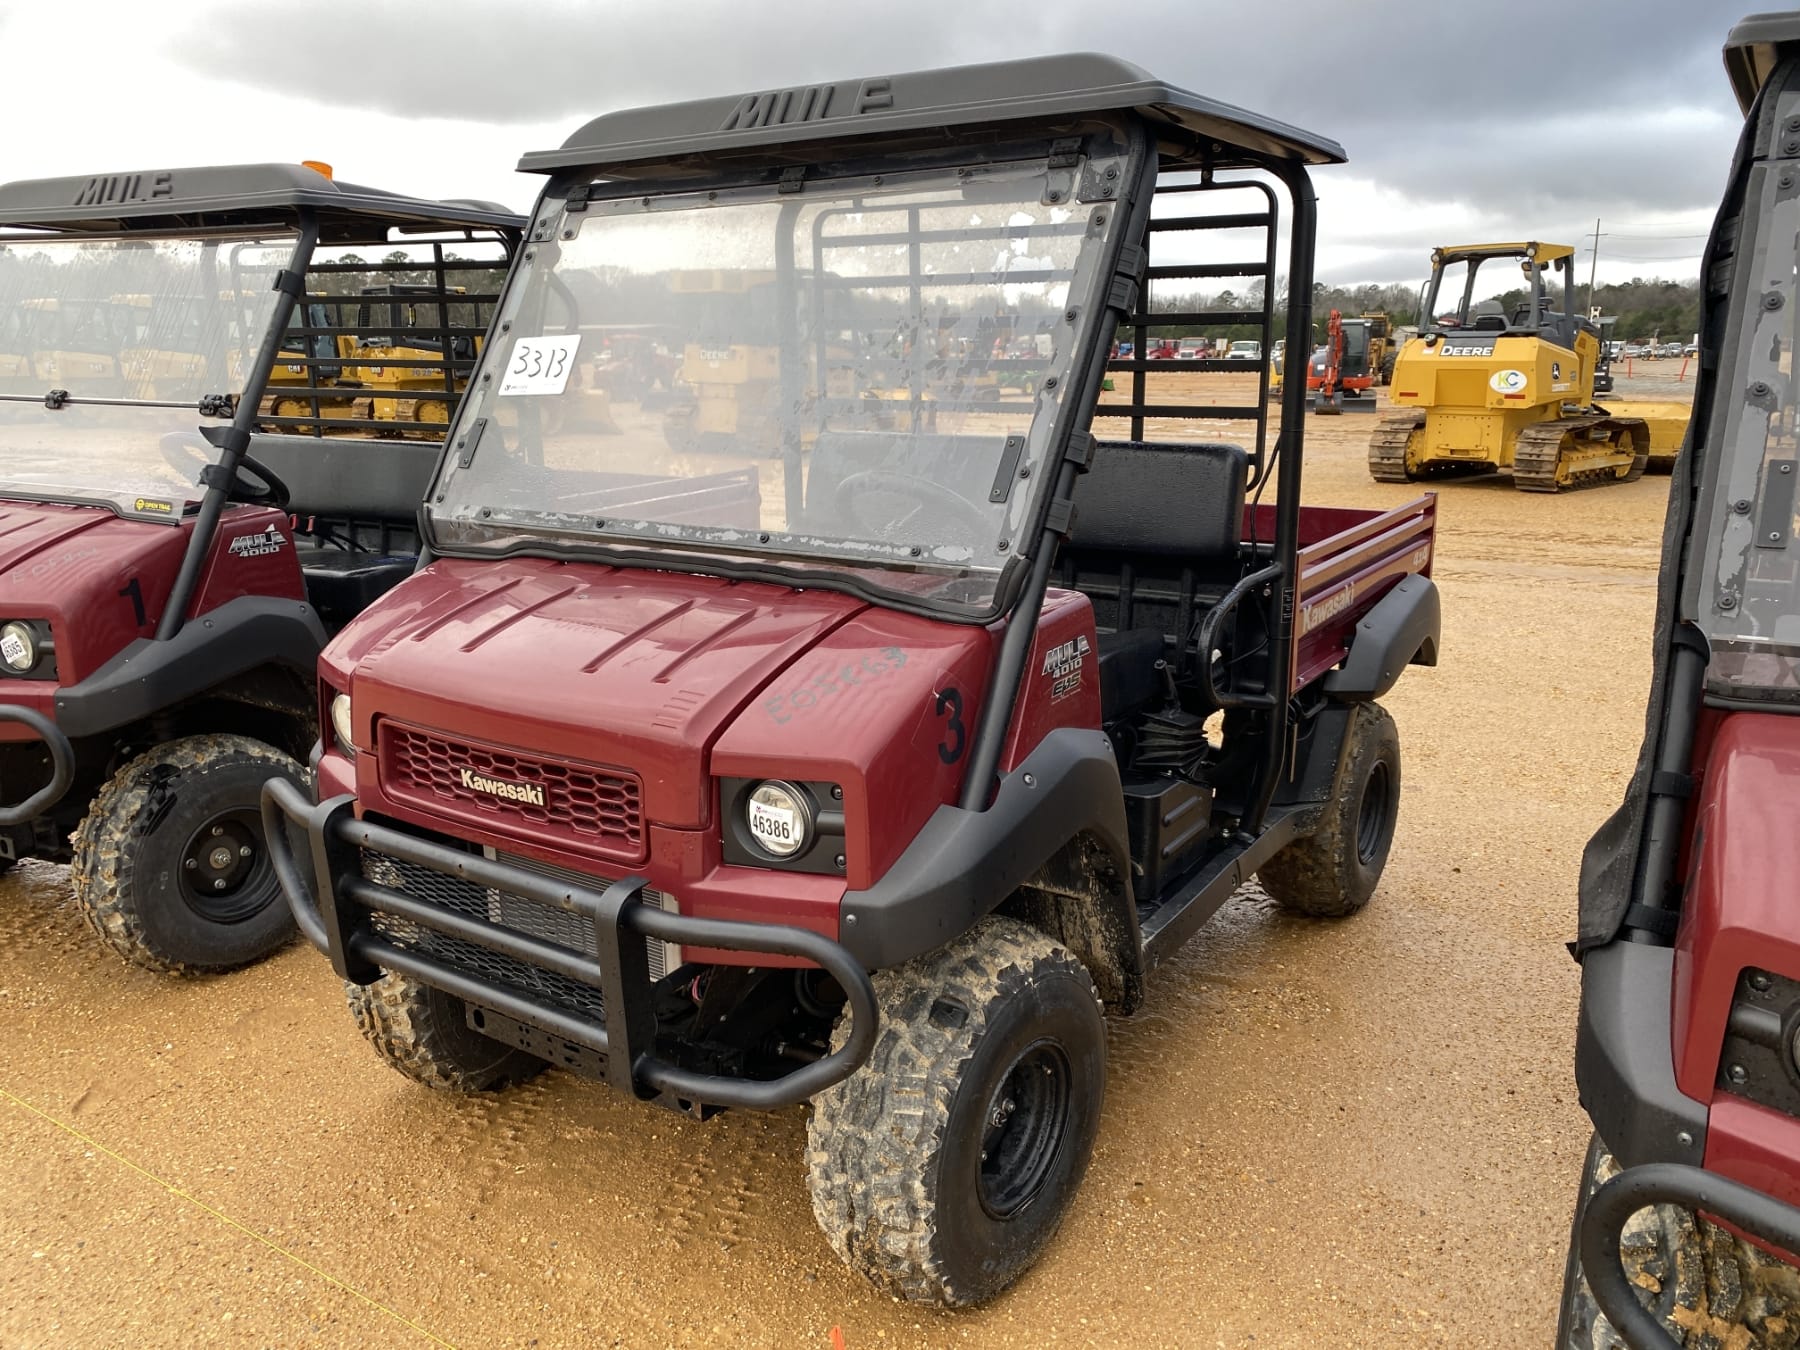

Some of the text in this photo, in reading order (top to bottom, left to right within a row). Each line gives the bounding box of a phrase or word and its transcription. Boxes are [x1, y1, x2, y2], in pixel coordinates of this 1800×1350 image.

[719, 78, 893, 131] MULE
[73, 172, 172, 206] MULE
[513, 345, 568, 378] 3313
[1440, 345, 1494, 356] DEERE
[1497, 371, 1519, 387] KC
[228, 529, 288, 553] MULE
[239, 545, 280, 557] 4000
[119, 578, 146, 627] 1
[1302, 581, 1355, 633] Kawasaki
[1041, 634, 1092, 676] MULE
[1053, 657, 1082, 679] 4010
[935, 687, 966, 765] 3
[460, 768, 544, 807] Kawasaki
[752, 813, 790, 840] 46386
